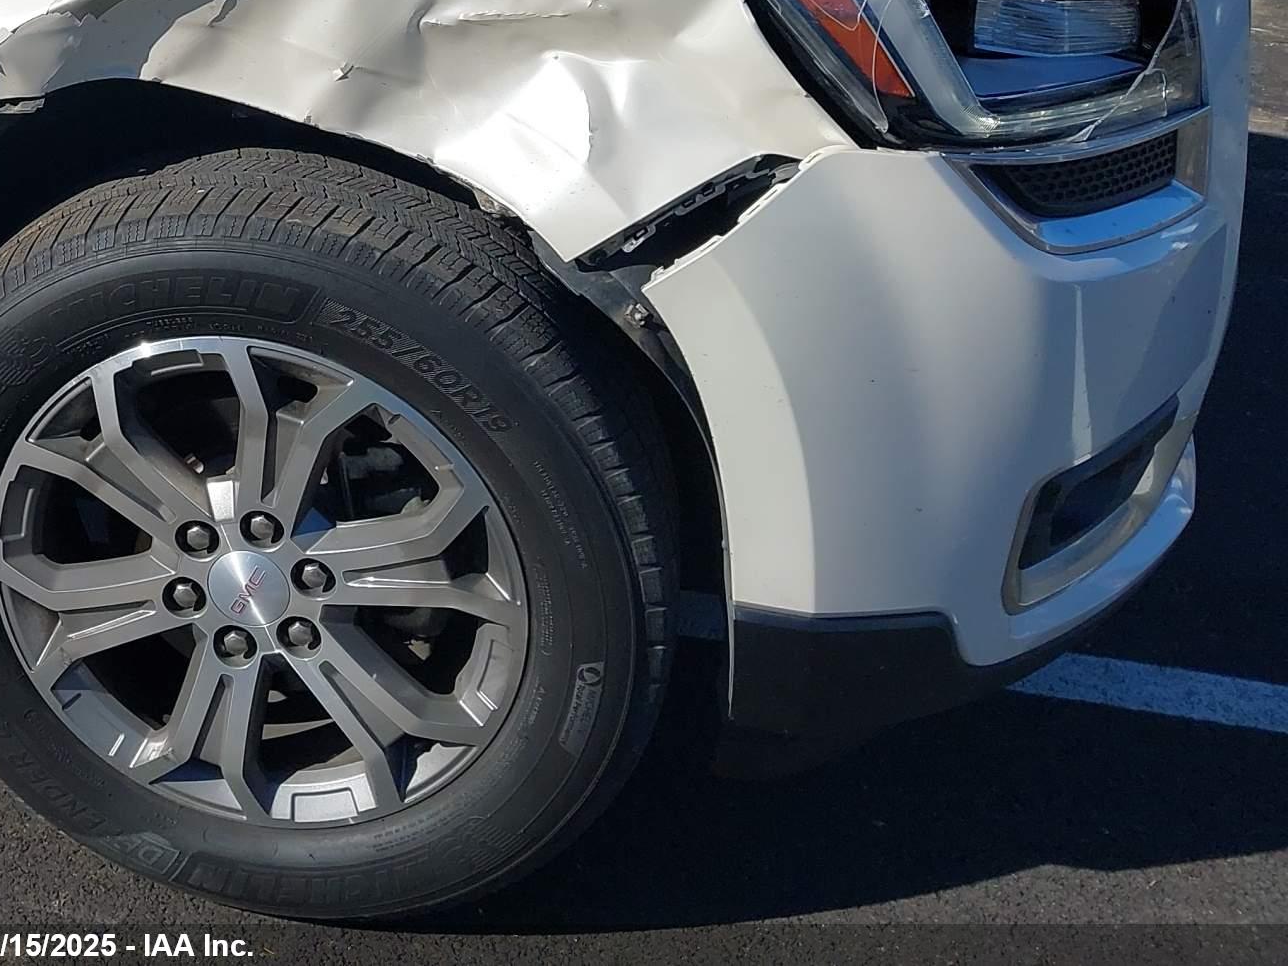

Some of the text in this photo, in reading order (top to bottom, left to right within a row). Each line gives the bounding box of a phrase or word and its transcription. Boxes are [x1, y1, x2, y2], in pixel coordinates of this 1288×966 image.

[48, 275, 303, 330] MICHELIN
[328, 309, 514, 433] 255/60R19
[229, 565, 267, 615] GMC
